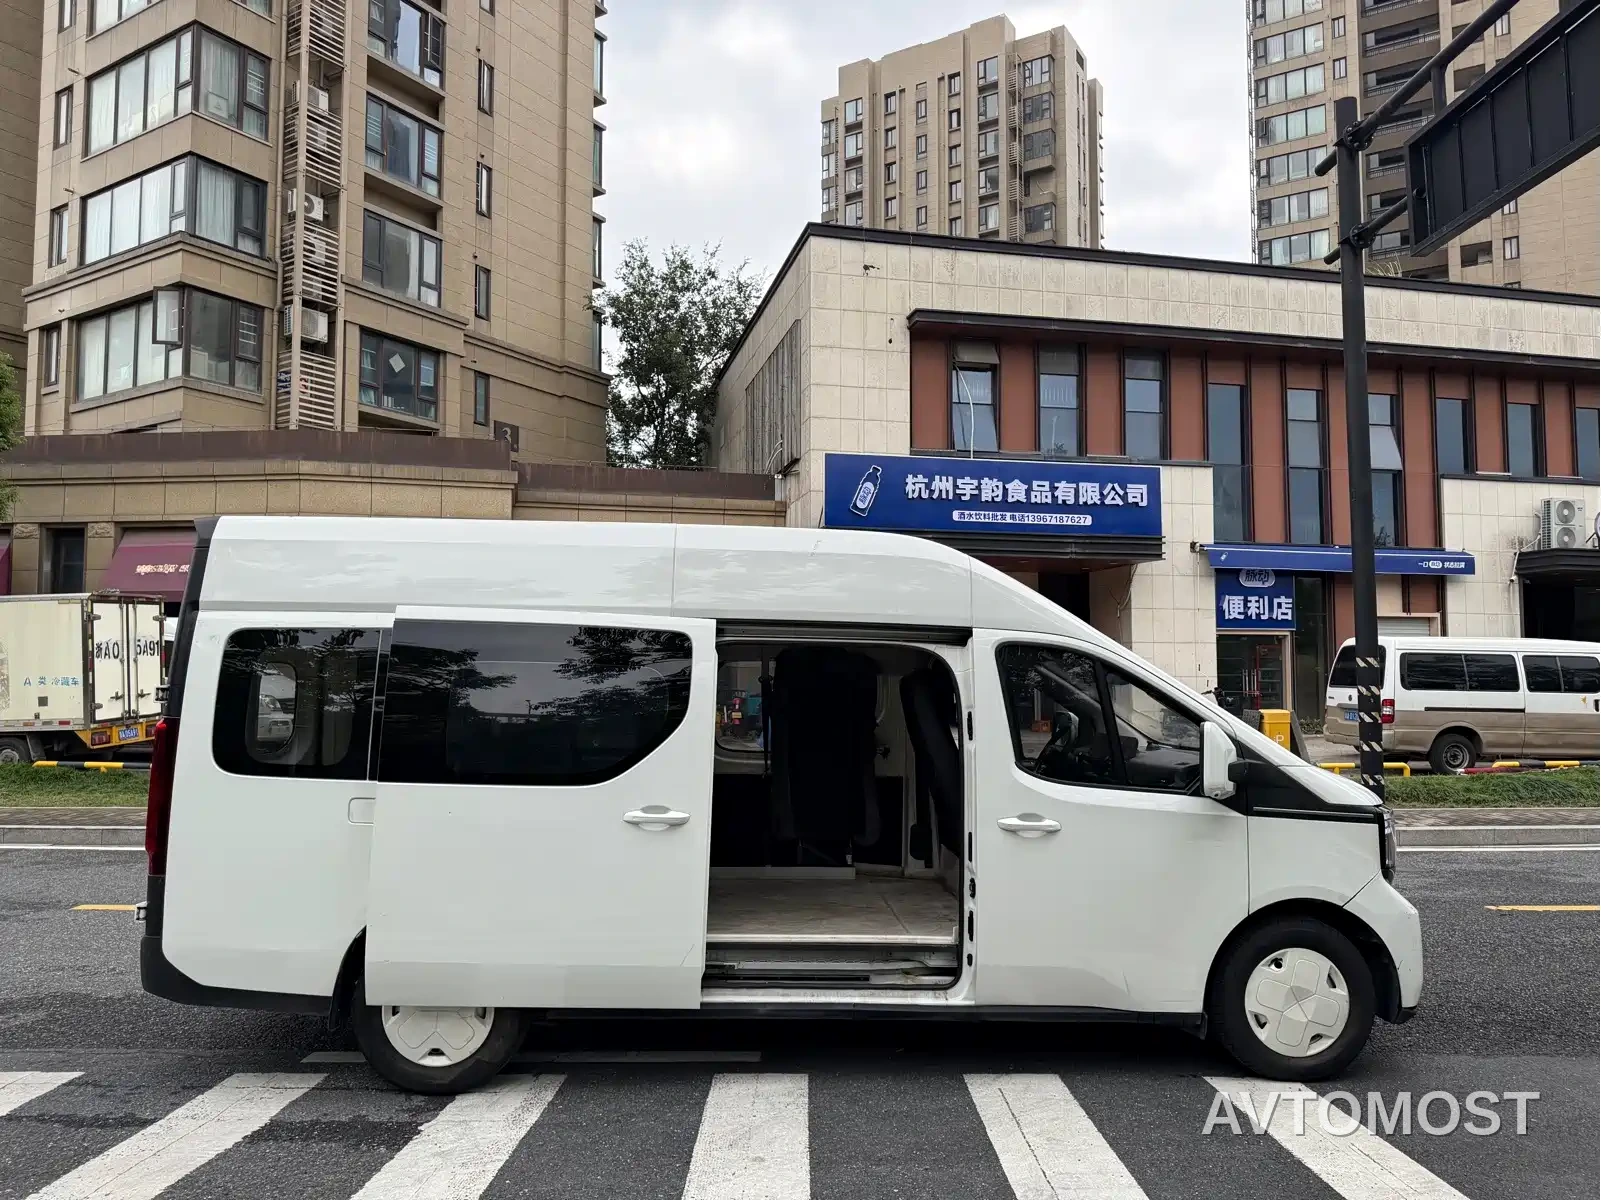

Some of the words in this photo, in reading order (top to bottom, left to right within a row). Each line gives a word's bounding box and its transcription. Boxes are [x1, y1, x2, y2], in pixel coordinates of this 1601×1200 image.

[905, 474, 1148, 507] 杭州宇韵食品有限公司
[957, 511, 1008, 521] 酒水饮料批发
[1009, 513, 1088, 524] 电话13967187627
[1222, 594, 1293, 621] 便利店
